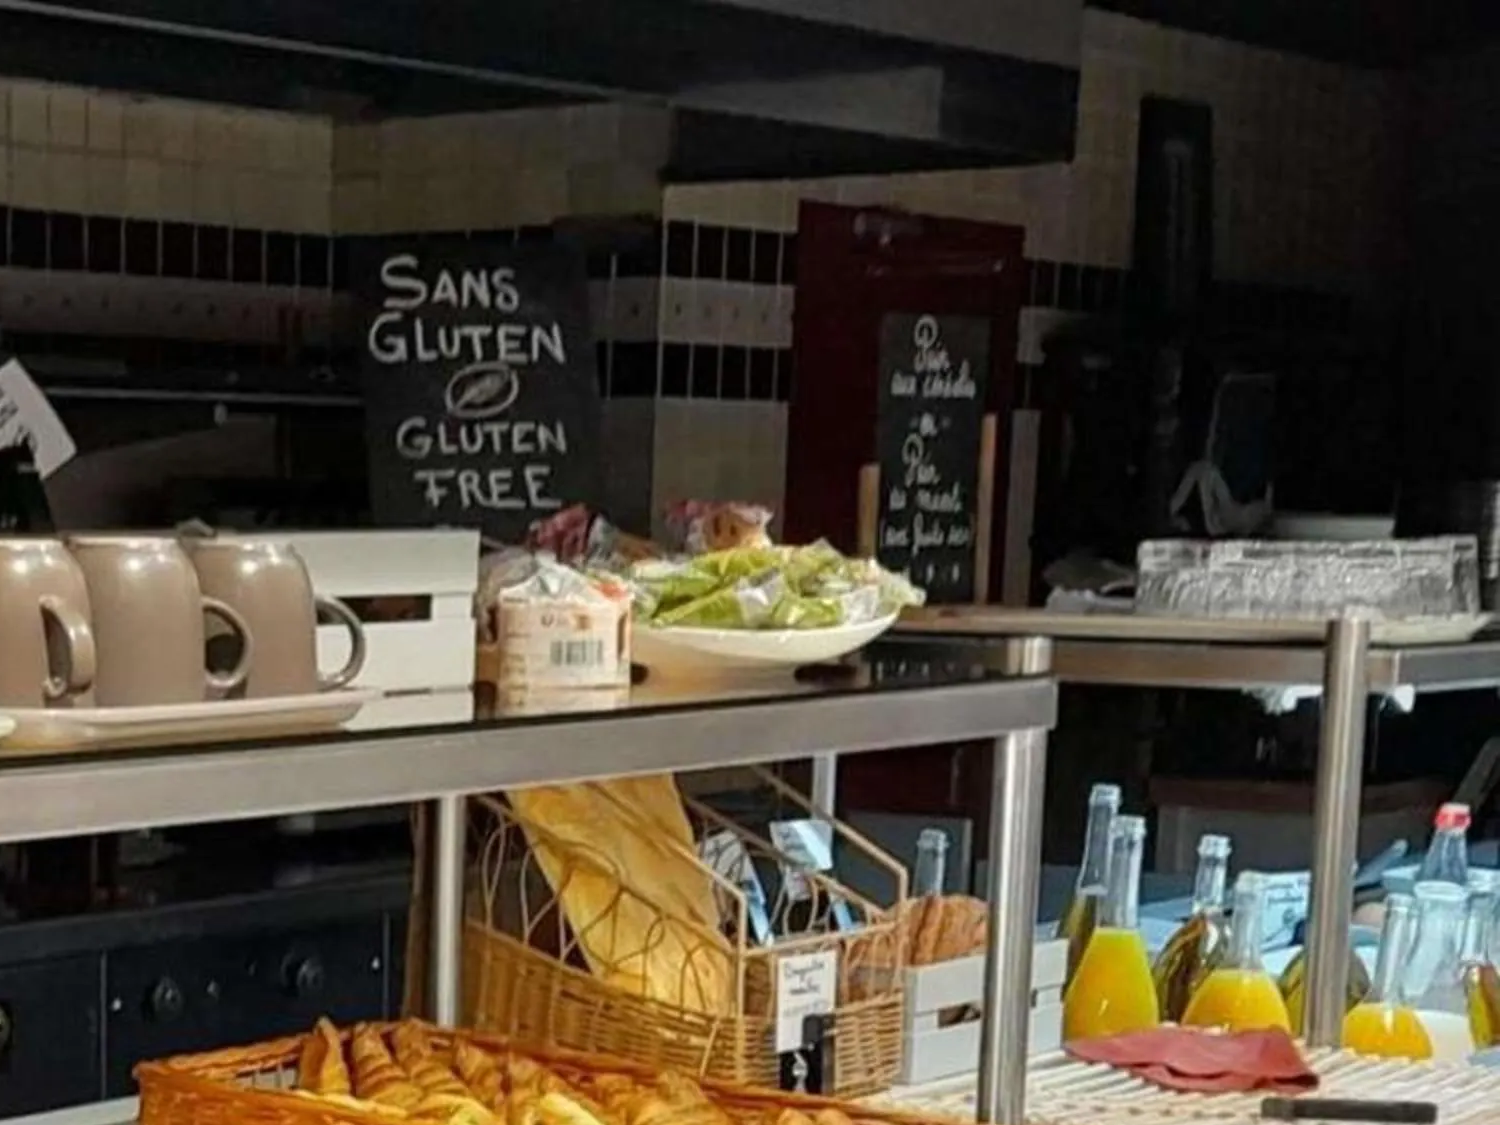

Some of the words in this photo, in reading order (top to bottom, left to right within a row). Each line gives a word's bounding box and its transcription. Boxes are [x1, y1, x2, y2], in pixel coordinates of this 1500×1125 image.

[380, 254, 520, 313] SANS
[368, 311, 566, 364] GLUTEN
[396, 416, 567, 459] GLUTEN
[414, 465, 562, 508] FREE
